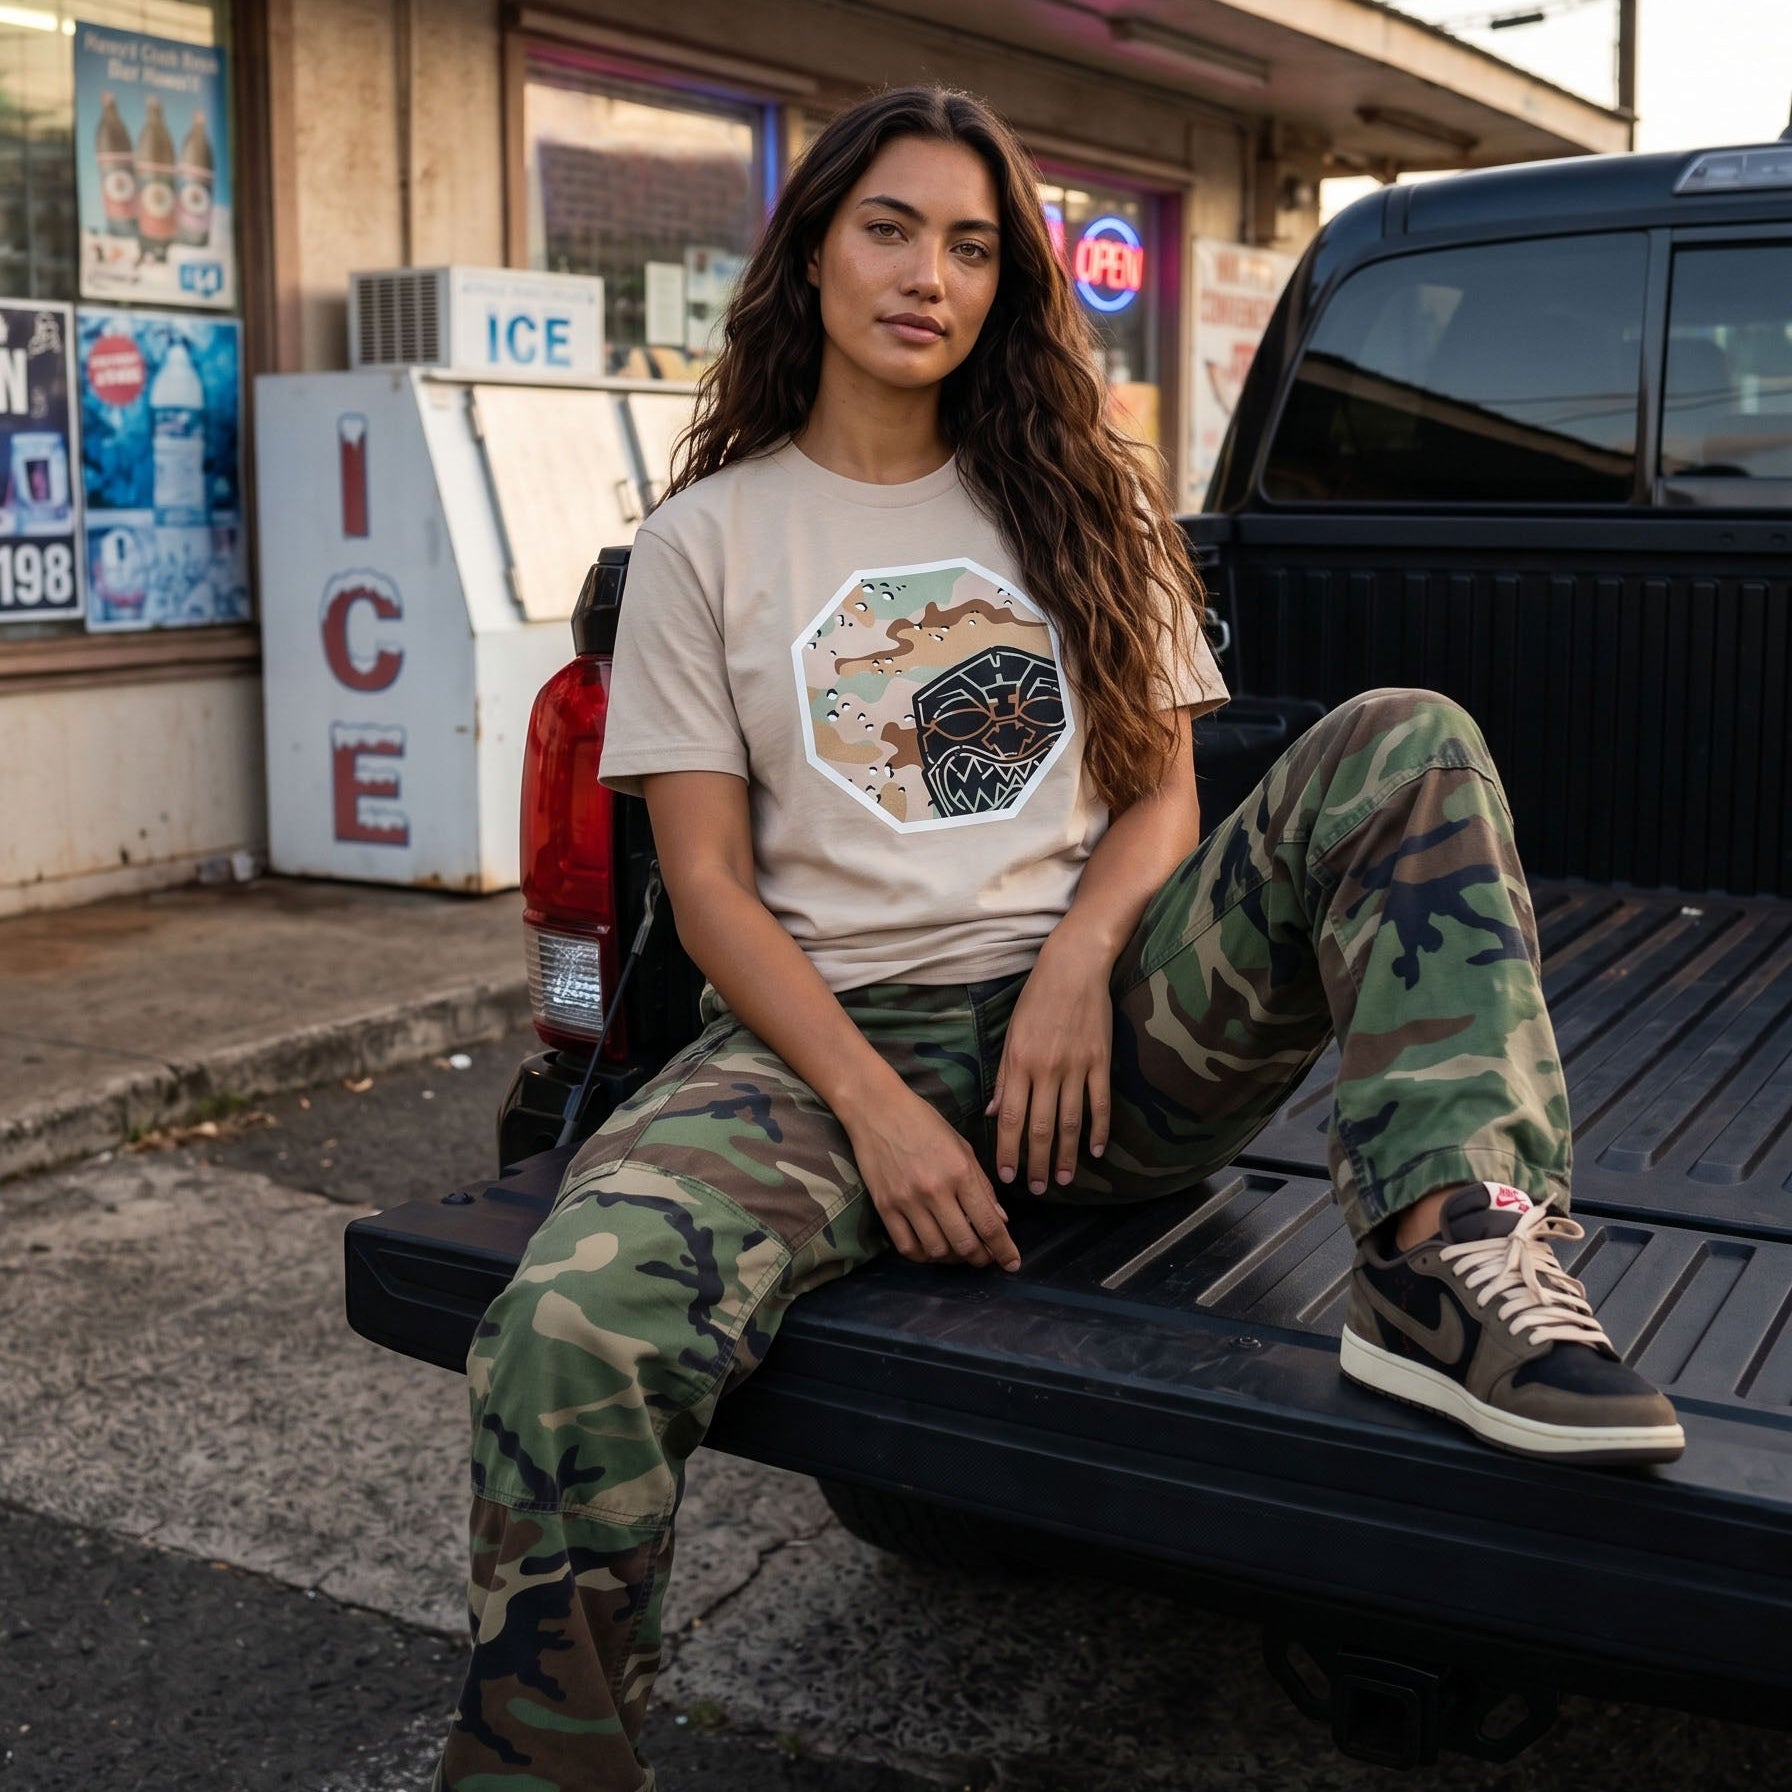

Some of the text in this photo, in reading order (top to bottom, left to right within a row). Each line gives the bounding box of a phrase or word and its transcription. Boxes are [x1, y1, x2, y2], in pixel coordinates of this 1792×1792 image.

[1075, 239, 1143, 291] OPEN
[488, 313, 571, 366] ICE
[0, 543, 74, 606] 198
[320, 413, 409, 847] ICE
